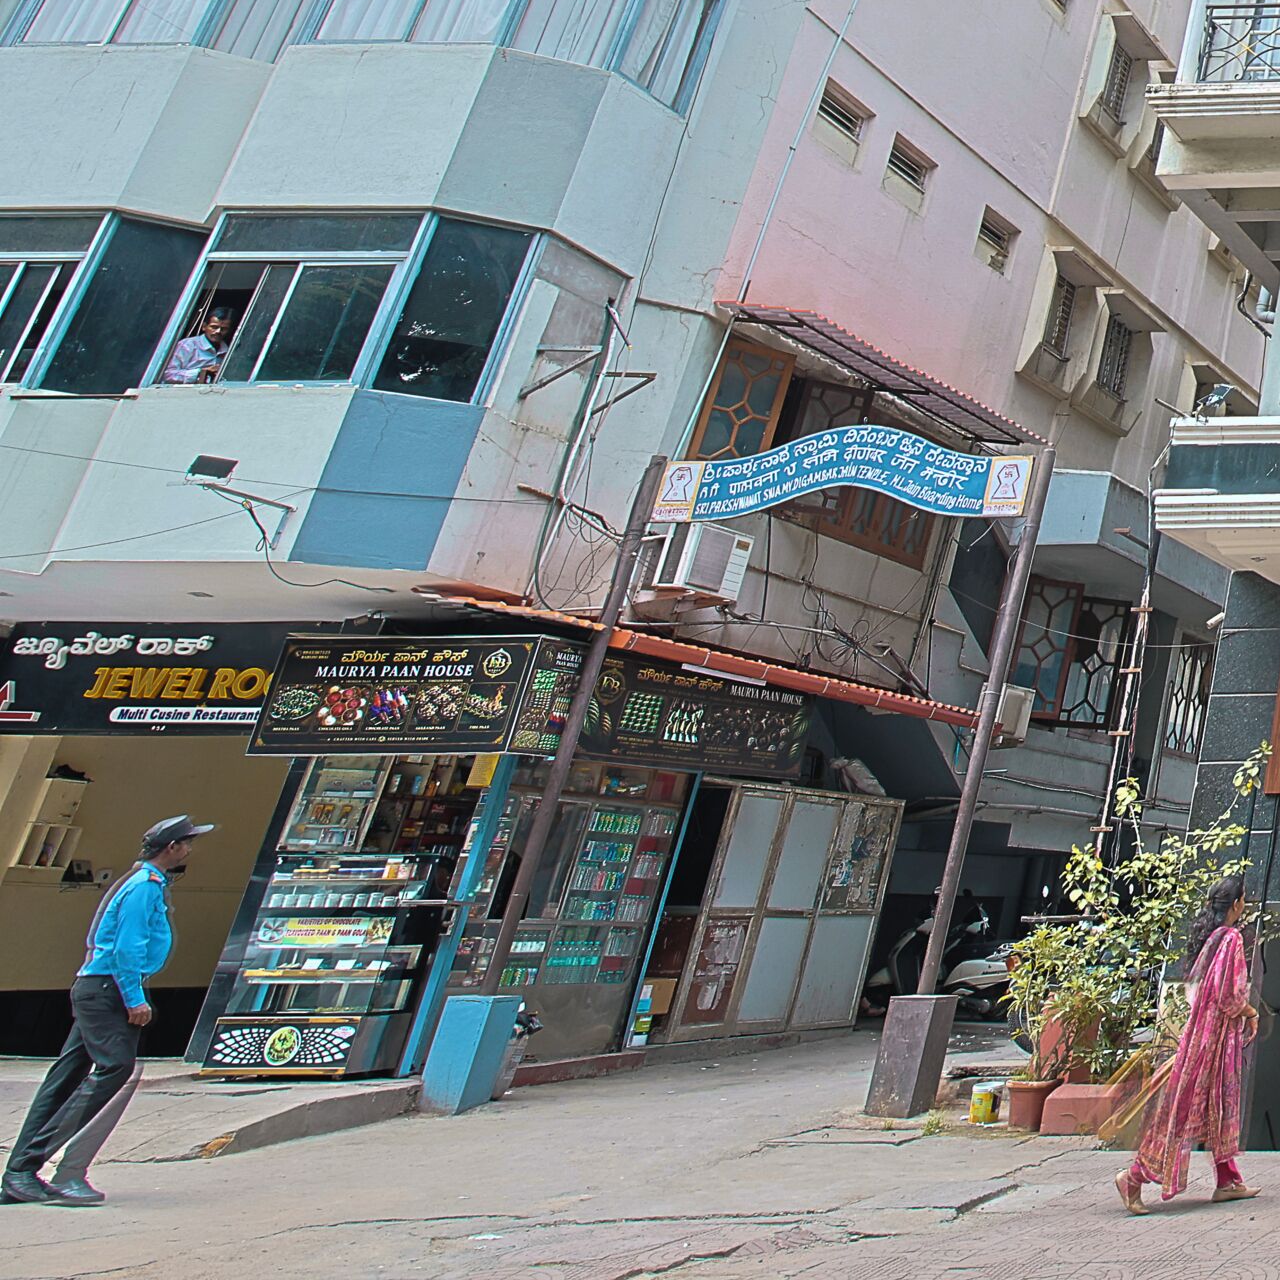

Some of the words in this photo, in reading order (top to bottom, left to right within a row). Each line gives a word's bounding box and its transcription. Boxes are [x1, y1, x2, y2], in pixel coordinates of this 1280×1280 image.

[918, 485, 957, 509] Boarding
[956, 494, 983, 510] Home
[136, 634, 215, 656] ರಾಕ್
[341, 650, 389, 663] ಮೌರ್ಯ
[393, 649, 428, 662] ಪಾನ್
[433, 649, 470, 662] ಹೌಸ್
[556, 651, 583, 663] MAURYA
[315, 665, 376, 678] MAURYA
[380, 665, 422, 677] PAAN
[423, 664, 474, 677] HOUSE
[83, 667, 209, 699] JEWEL
[207, 667, 274, 700] RO
[730, 684, 760, 699] MAURYA
[760, 689, 781, 703] PAAN
[781, 692, 804, 706] HOUSE
[117, 708, 147, 720] Multi
[149, 708, 193, 721] Cusine
[194, 709, 261, 721] Restaurant
